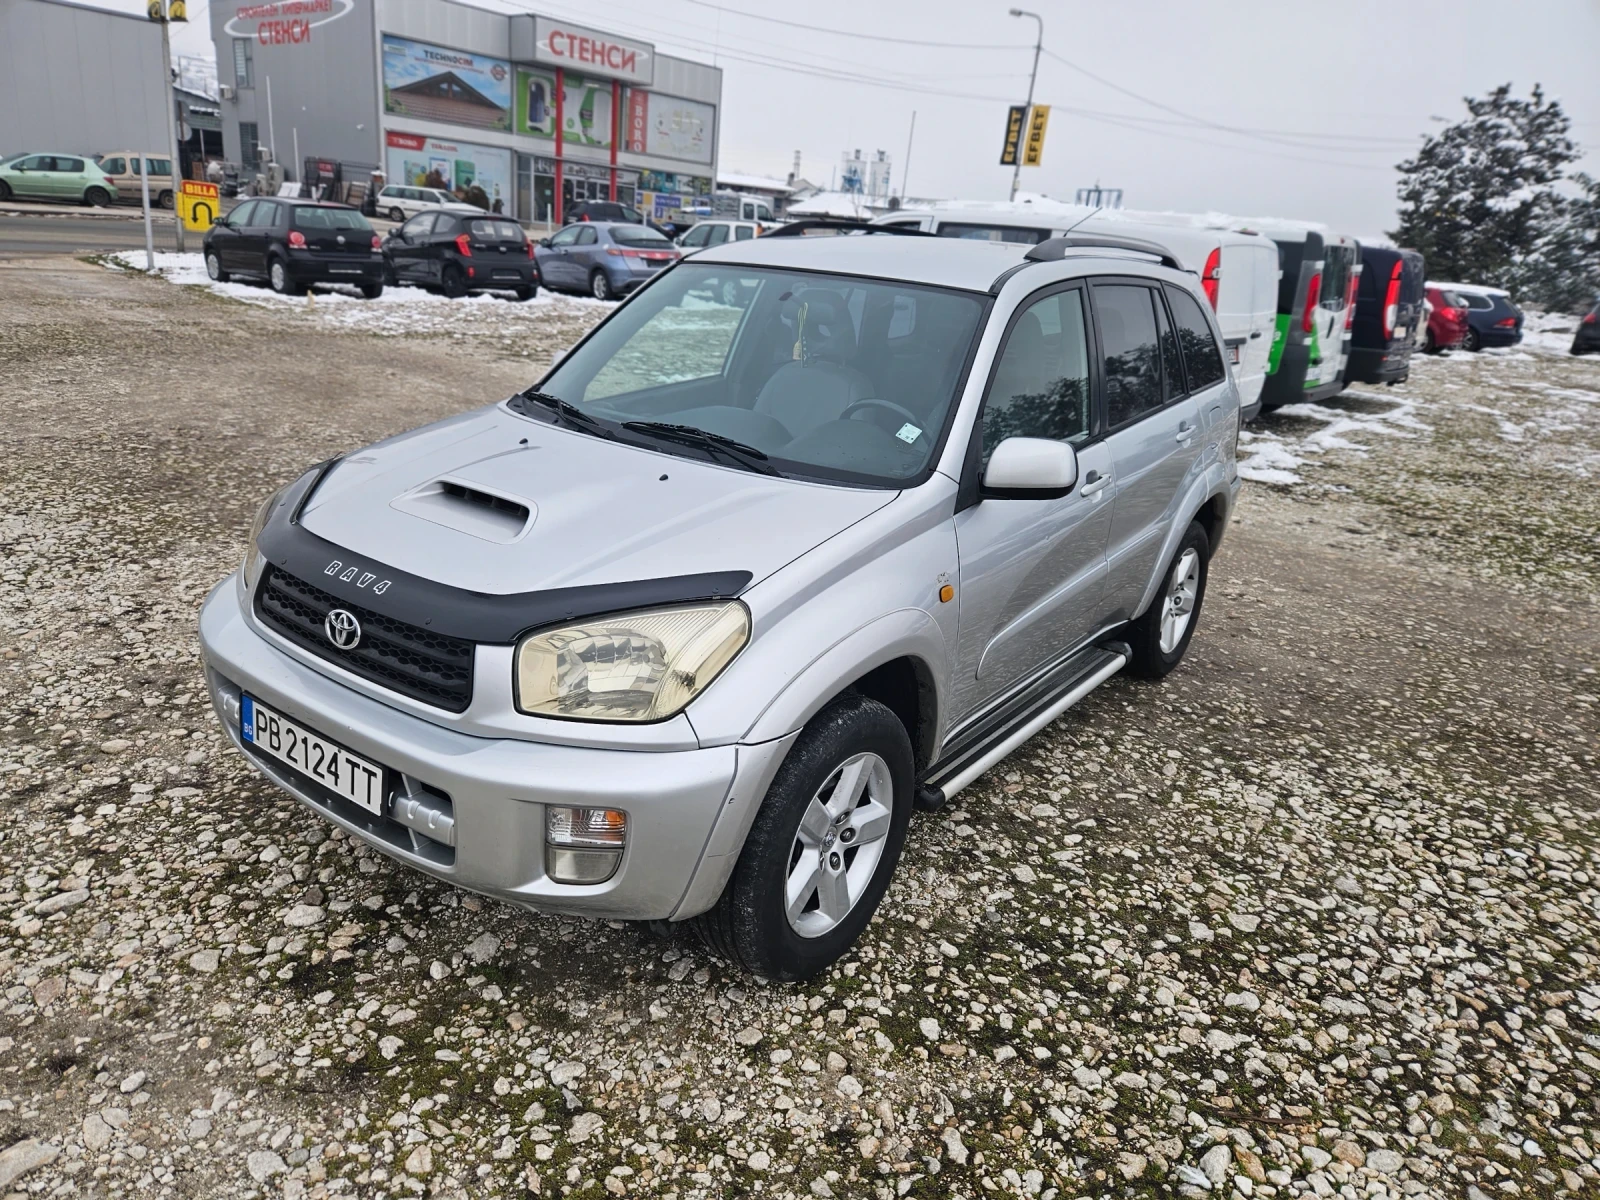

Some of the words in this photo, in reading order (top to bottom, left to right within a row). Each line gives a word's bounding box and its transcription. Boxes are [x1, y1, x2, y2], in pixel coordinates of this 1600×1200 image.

[258, 19, 311, 45] СТЕНСИ
[423, 49, 474, 67] TECHNOCIM
[548, 30, 636, 73] СТЕНСИ
[1003, 109, 1022, 162] EFBET
[1027, 110, 1045, 163] EFBET
[185, 183, 217, 197] BILLA
[324, 560, 392, 595] RAV4
[244, 722, 253, 736] BG
[255, 707, 282, 752] PB
[285, 727, 340, 788] 2124
[345, 757, 378, 806] TT
